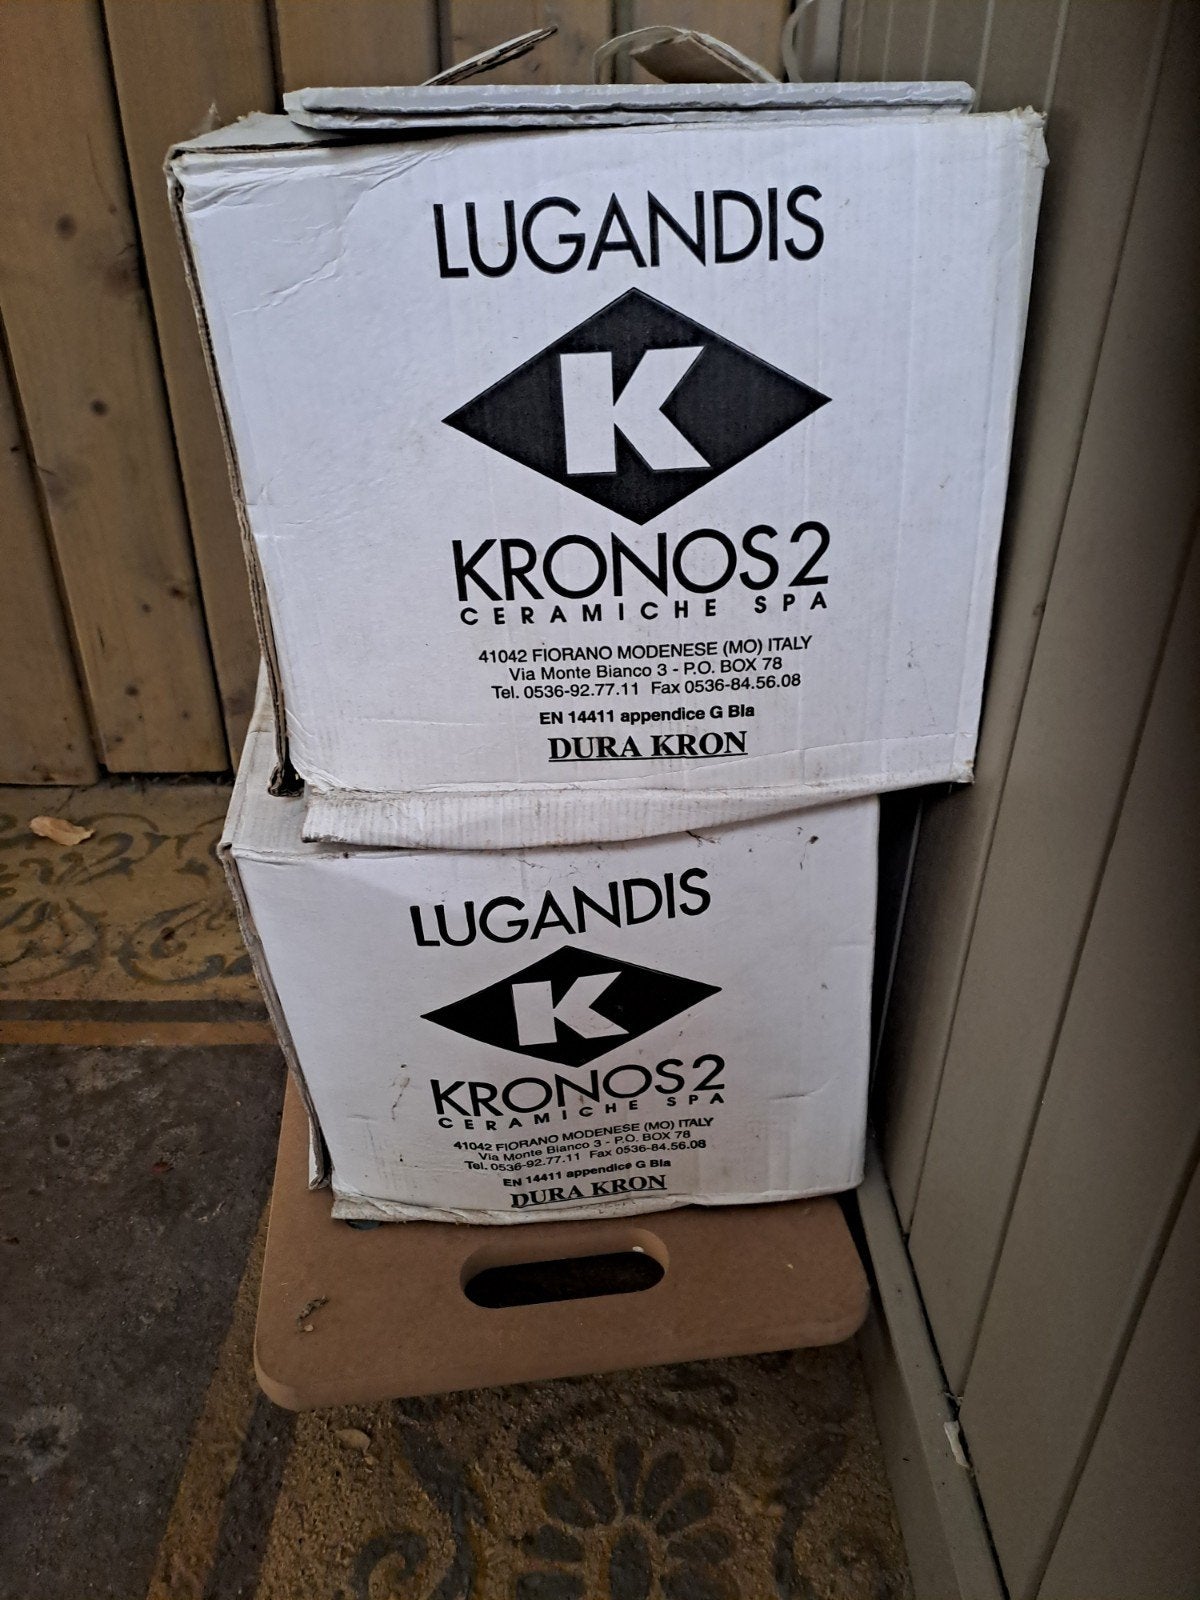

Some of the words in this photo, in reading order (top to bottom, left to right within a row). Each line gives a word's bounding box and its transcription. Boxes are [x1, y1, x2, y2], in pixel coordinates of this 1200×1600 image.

[433, 184, 825, 279] LUGANDIS
[560, 345, 712, 475] K
[460, 598, 717, 626] CERAMICHE
[754, 591, 828, 614] SPA
[478, 649, 528, 664] 41042
[532, 645, 613, 663] FIORANO
[617, 641, 718, 660] MODENESE
[723, 638, 763, 657] (MO)
[768, 635, 813, 652] ITALY
[508, 667, 536, 682] Via
[541, 665, 591, 680] Monte
[596, 662, 652, 679] Bianco
[657, 663, 668, 677] 3
[683, 660, 715, 676] P.O.
[720, 657, 757, 674] BOX
[762, 656, 783, 671] 78
[491, 685, 520, 700] Tel.
[523, 681, 639, 699] 0536-92.77.11
[651, 681, 681, 695] Fax
[684, 673, 802, 694] 0536-84.56.08
[539, 711, 564, 725] EN
[568, 709, 615, 724] 14411
[620, 706, 706, 726] appendice
[709, 705, 724, 720] G
[547, 735, 642, 763] DURA
[649, 730, 750, 758] KRON
[409, 867, 712, 947] LUGANDIS
[511, 970, 631, 1047] K
[438, 1099, 639, 1131] CERAMICHE
[666, 1092, 726, 1108] SPA
[453, 1141, 493, 1152] 41042
[495, 1134, 560, 1153] FIORANO
[562, 1122, 641, 1143] MODENESE
[643, 1120, 676, 1132] (MO)
[678, 1116, 715, 1129] ITALY
[478, 1151, 500, 1162] Via
[503, 1148, 543, 1162] Monte
[546, 1140, 591, 1155] Bianco
[593, 1139, 603, 1149] 3
[614, 1132, 640, 1145] P.O.
[642, 1131, 672, 1142] BOX
[674, 1129, 692, 1140] 78
[464, 1160, 489, 1171] Tel.
[490, 1152, 581, 1172] 0536-92.77.11
[589, 1149, 613, 1159] Fax
[615, 1138, 708, 1155] 0536-84.56.08
[503, 1178, 523, 1188] EN
[525, 1170, 563, 1185] 14411
[566, 1161, 633, 1179] appendice
[635, 1160, 647, 1169] G
[511, 1184, 585, 1209] DURA
[590, 1174, 668, 1198] KRON
